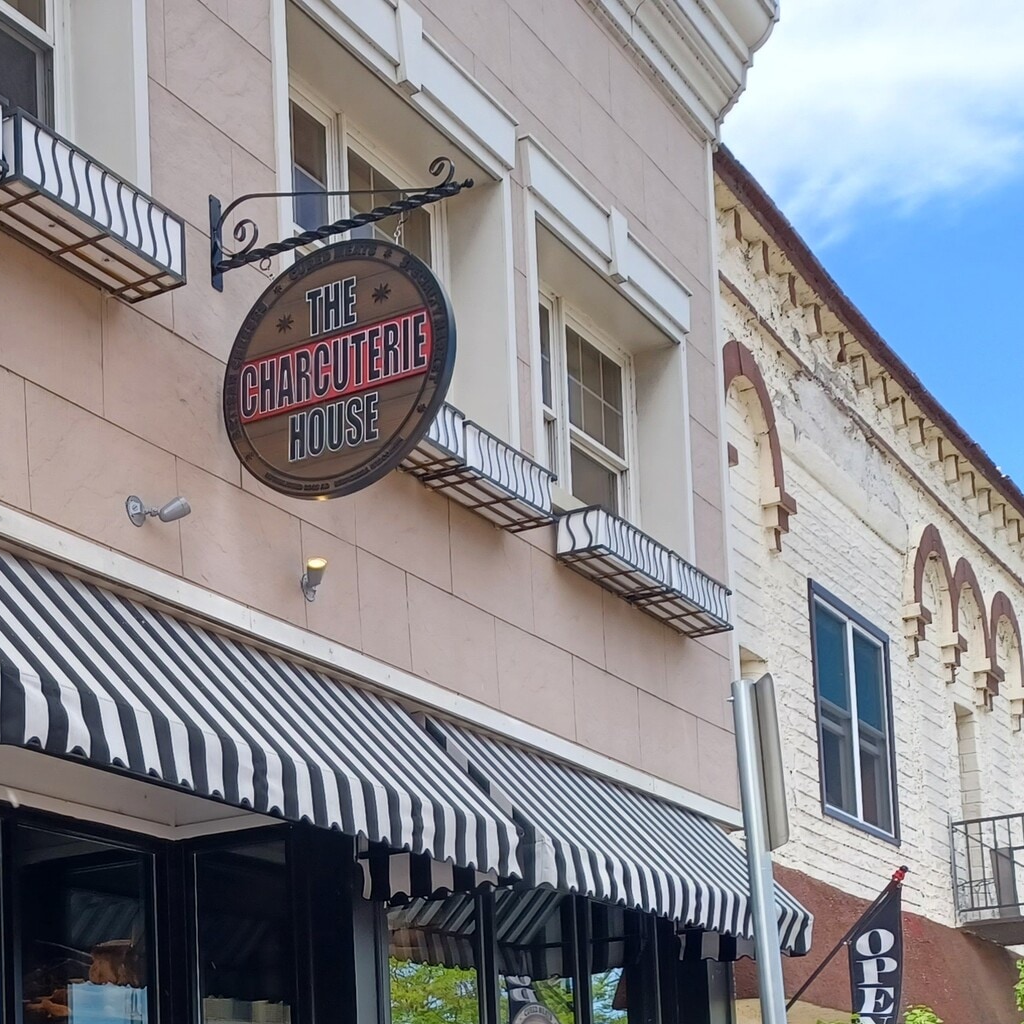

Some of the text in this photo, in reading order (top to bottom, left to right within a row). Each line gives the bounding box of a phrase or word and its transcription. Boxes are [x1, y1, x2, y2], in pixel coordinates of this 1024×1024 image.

[306, 276, 358, 337] THE
[240, 311, 428, 419] CHARCUTERIE
[288, 392, 379, 463] HOUSE
